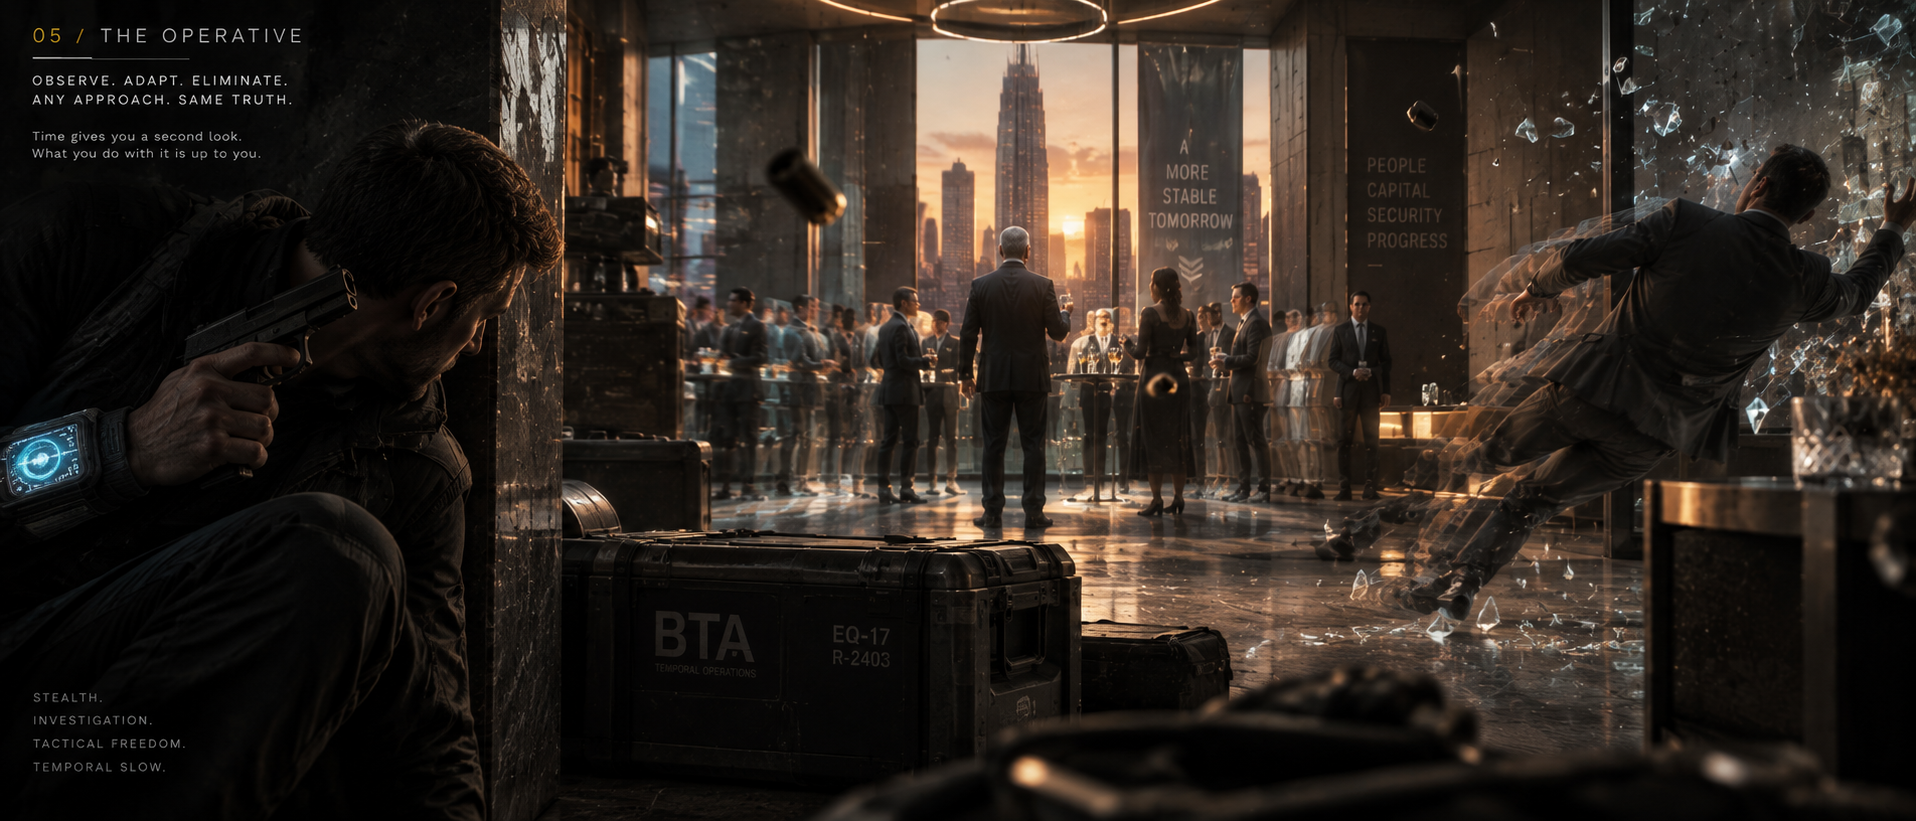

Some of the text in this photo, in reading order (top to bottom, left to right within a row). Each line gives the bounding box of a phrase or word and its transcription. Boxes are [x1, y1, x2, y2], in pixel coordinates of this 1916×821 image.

[1179, 139, 1189, 155] A
[1166, 164, 1209, 180] MORE
[1367, 157, 1427, 173] PEOPLE
[1163, 188, 1217, 205] STABLE
[1367, 182, 1431, 198] CAPITAL
[1149, 212, 1234, 229] TOMORROW
[1367, 207, 1443, 223] SECURITY
[1367, 232, 1448, 249] PROGRESS
[655, 610, 755, 663] BTA
[832, 624, 891, 646] EQ-17
[832, 649, 891, 668] R-2403
[655, 663, 757, 679] TEMPORAL OPERATIONS
